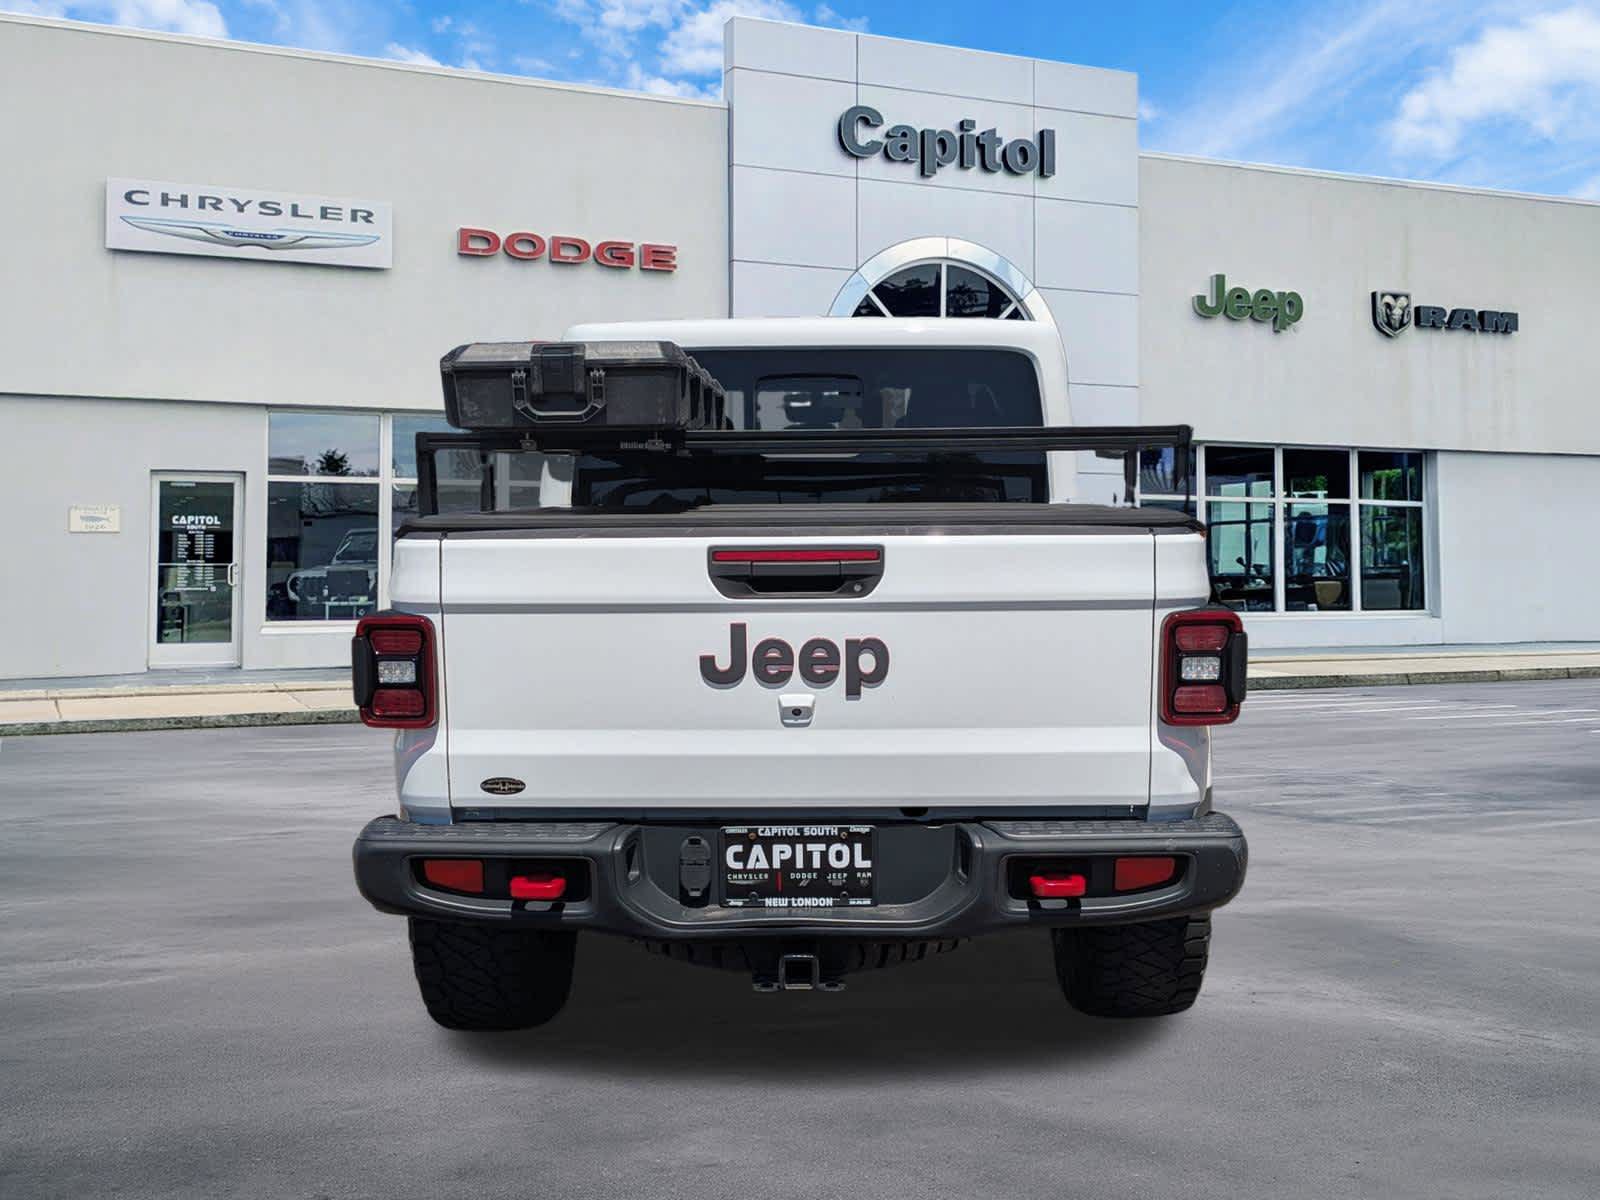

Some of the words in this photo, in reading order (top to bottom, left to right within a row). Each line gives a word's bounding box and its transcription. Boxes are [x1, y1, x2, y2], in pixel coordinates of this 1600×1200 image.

[838, 105, 1056, 177] Capitol
[124, 189, 375, 224] CHRYSLER
[457, 227, 678, 272] DODGE
[1192, 273, 1304, 332] Jeep
[1414, 305, 1519, 334] RAM
[172, 515, 221, 525] CAPITOL
[699, 622, 890, 701] Jeep
[758, 827, 801, 837] CAPITOL
[803, 827, 838, 836] SOUTH
[726, 843, 872, 870] CAPITOL
[765, 897, 789, 907] NEW
[791, 897, 833, 907] LONDON
